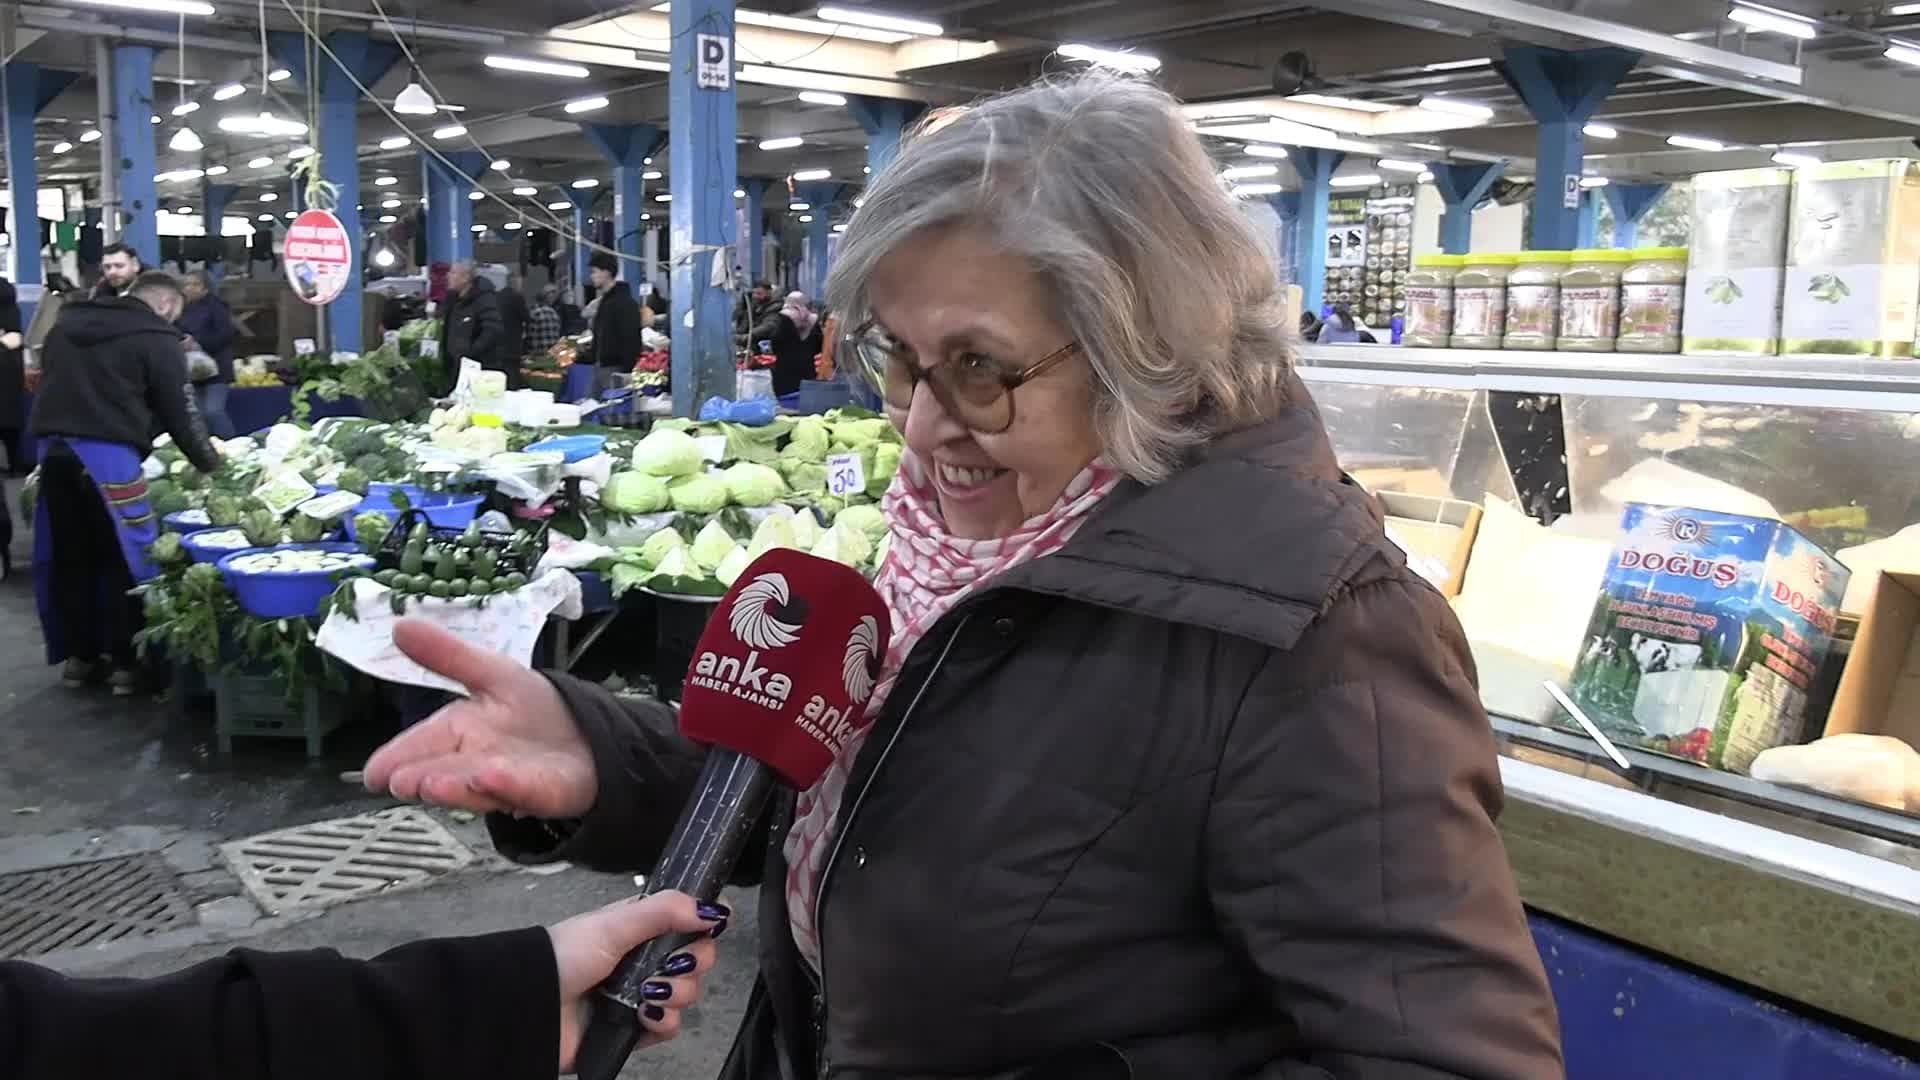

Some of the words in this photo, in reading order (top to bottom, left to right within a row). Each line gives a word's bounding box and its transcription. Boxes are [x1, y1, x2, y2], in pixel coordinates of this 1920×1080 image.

[703, 39, 724, 64] D
[834, 468, 856, 493] 50
[1621, 550, 1737, 587] DOĞUŞ
[696, 651, 792, 700] anka
[691, 676, 730, 693] HABER
[732, 686, 784, 710] AJANSI
